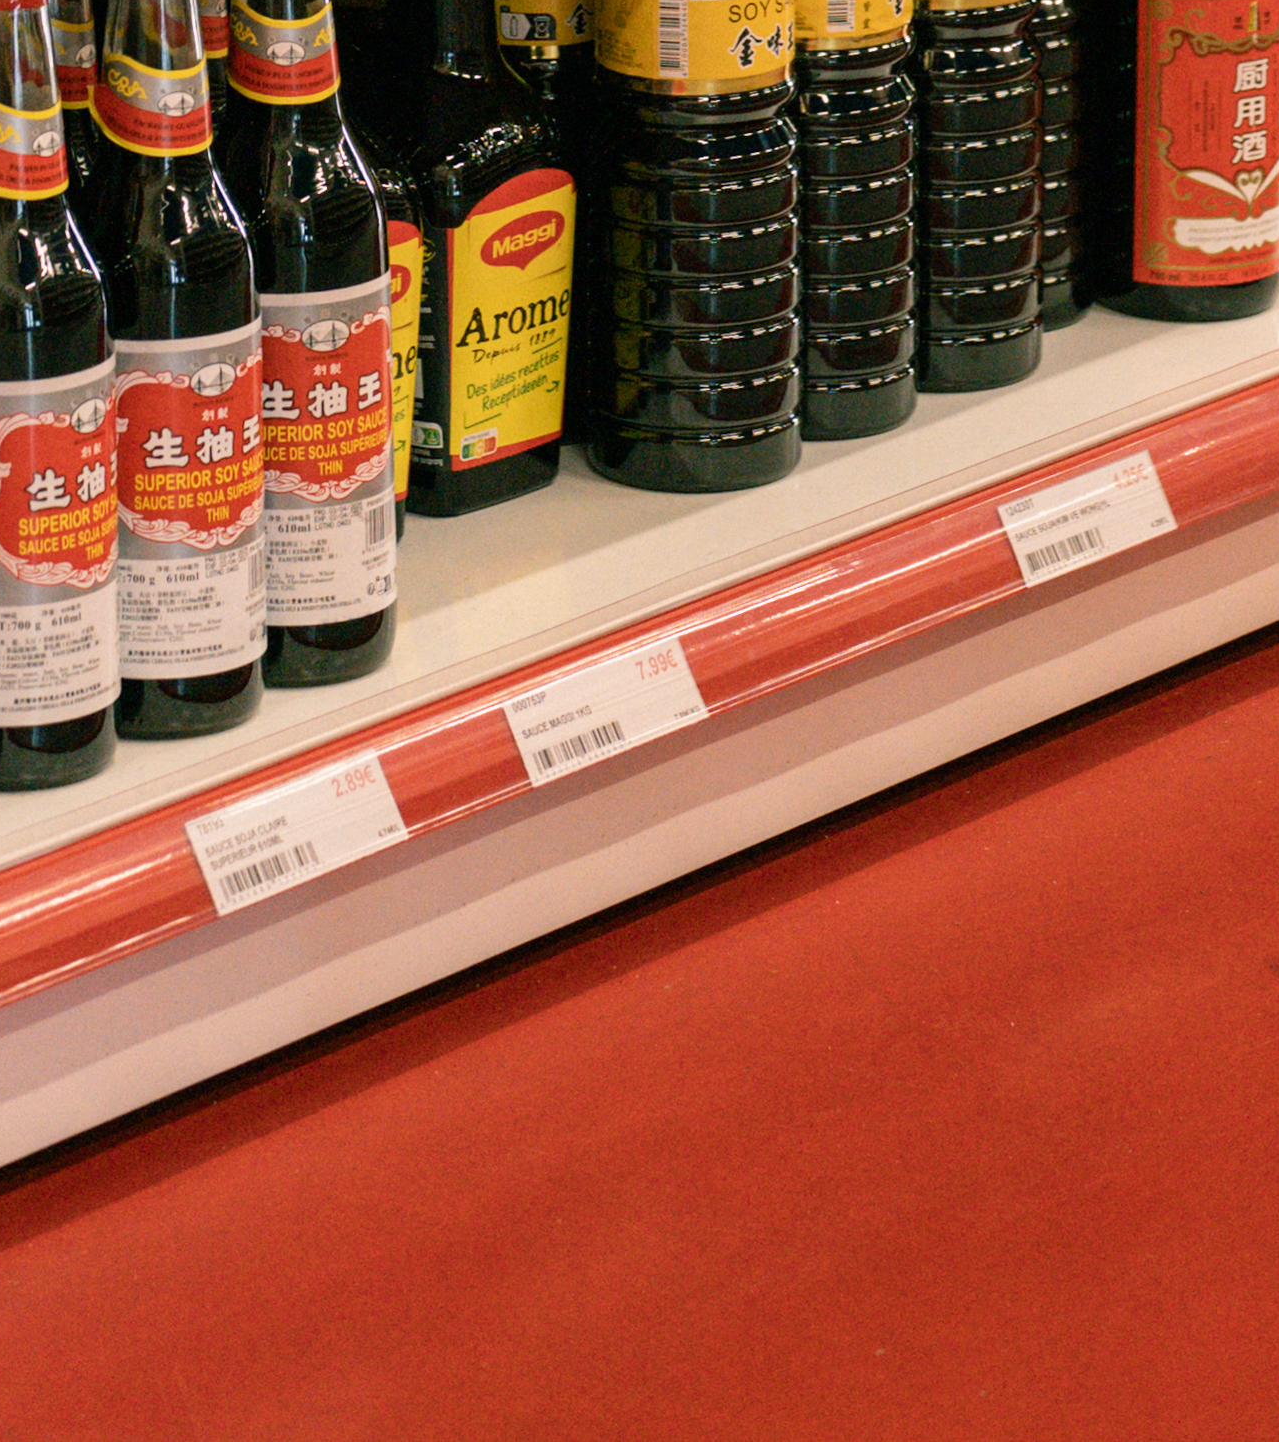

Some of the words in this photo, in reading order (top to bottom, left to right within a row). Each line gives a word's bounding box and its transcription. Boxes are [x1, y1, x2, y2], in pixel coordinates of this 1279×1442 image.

[729, 1, 769, 23] SOY
[491, 217, 558, 254] Maggi
[457, 287, 570, 349] Arome
[472, 343, 523, 363] Depuis
[466, 382, 487, 399] Des
[488, 373, 514, 394] idées
[518, 350, 560, 381] recettes
[328, 418, 354, 439] SOY
[357, 411, 387, 431] SAUCE
[135, 469, 193, 489] SUPERIOR
[197, 465, 220, 484] SOY
[317, 459, 344, 475] THIN
[135, 495, 166, 511] SAUCE
[206, 506, 230, 523] THIN
[19, 514, 77, 535] SUPERIOR
[82, 509, 106, 528] SOY
[19, 541, 52, 555] SAUCE
[635, 649, 678, 680] 7.99€
[522, 723, 550, 739] SAUCE
[331, 764, 377, 798] 2.89€
